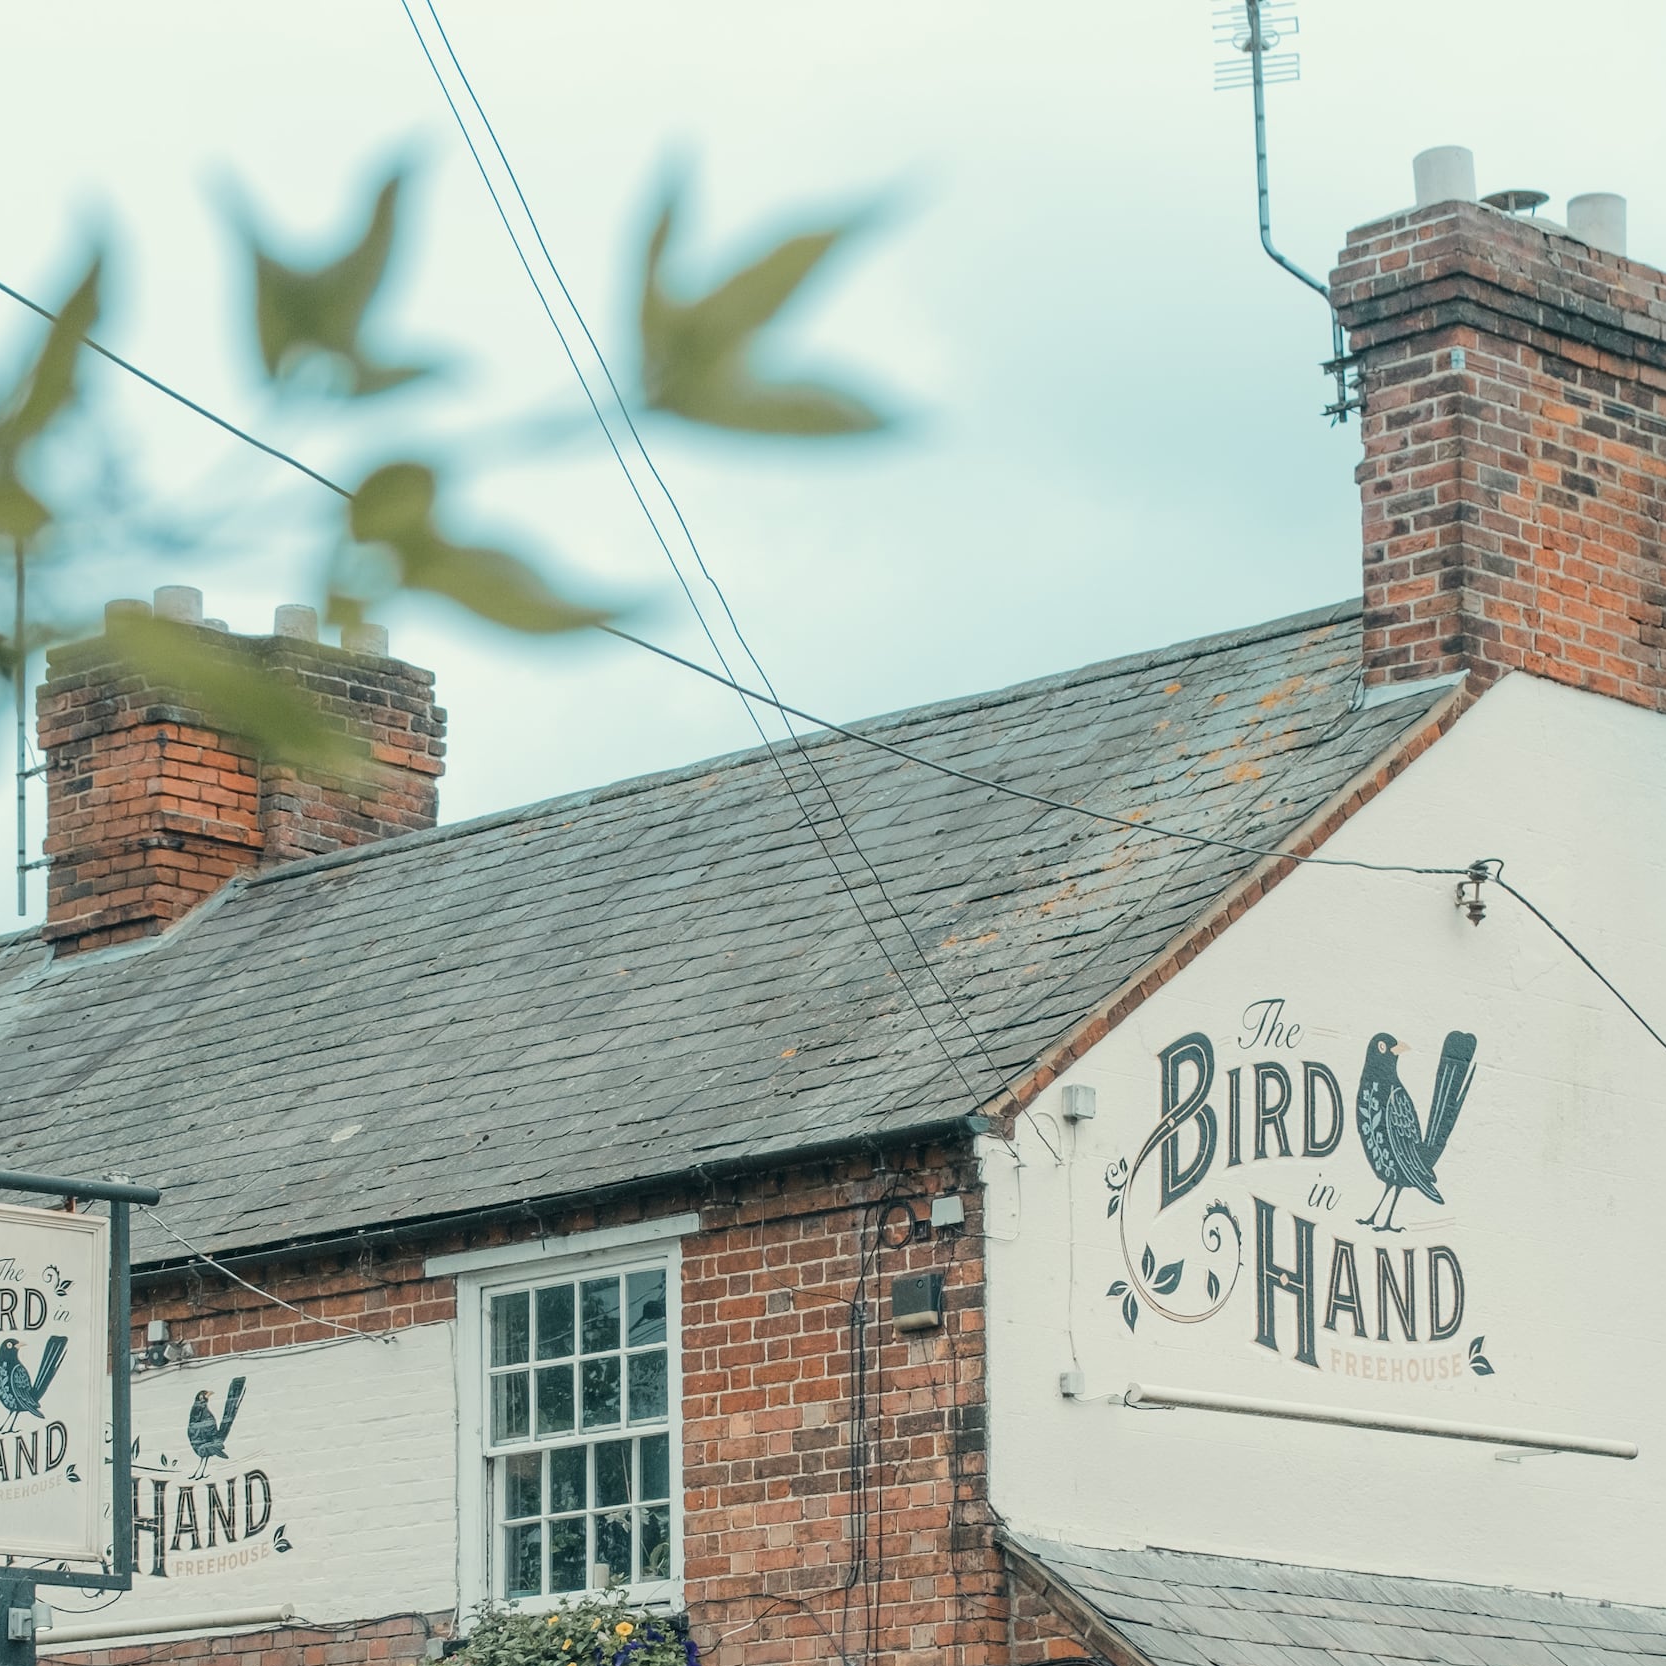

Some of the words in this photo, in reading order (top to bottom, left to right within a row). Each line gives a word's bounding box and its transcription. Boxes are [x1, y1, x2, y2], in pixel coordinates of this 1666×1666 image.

[1238, 998, 1304, 1050] The
[1158, 1031, 1344, 1212] BIRD
[1308, 1173, 1342, 1211] in
[1251, 1194, 1465, 1369] HAND
[52, 1304, 74, 1323] in
[1330, 1348, 1463, 1383] FREEHOUSE
[175, 1542, 271, 1577] FREEHOUSE
